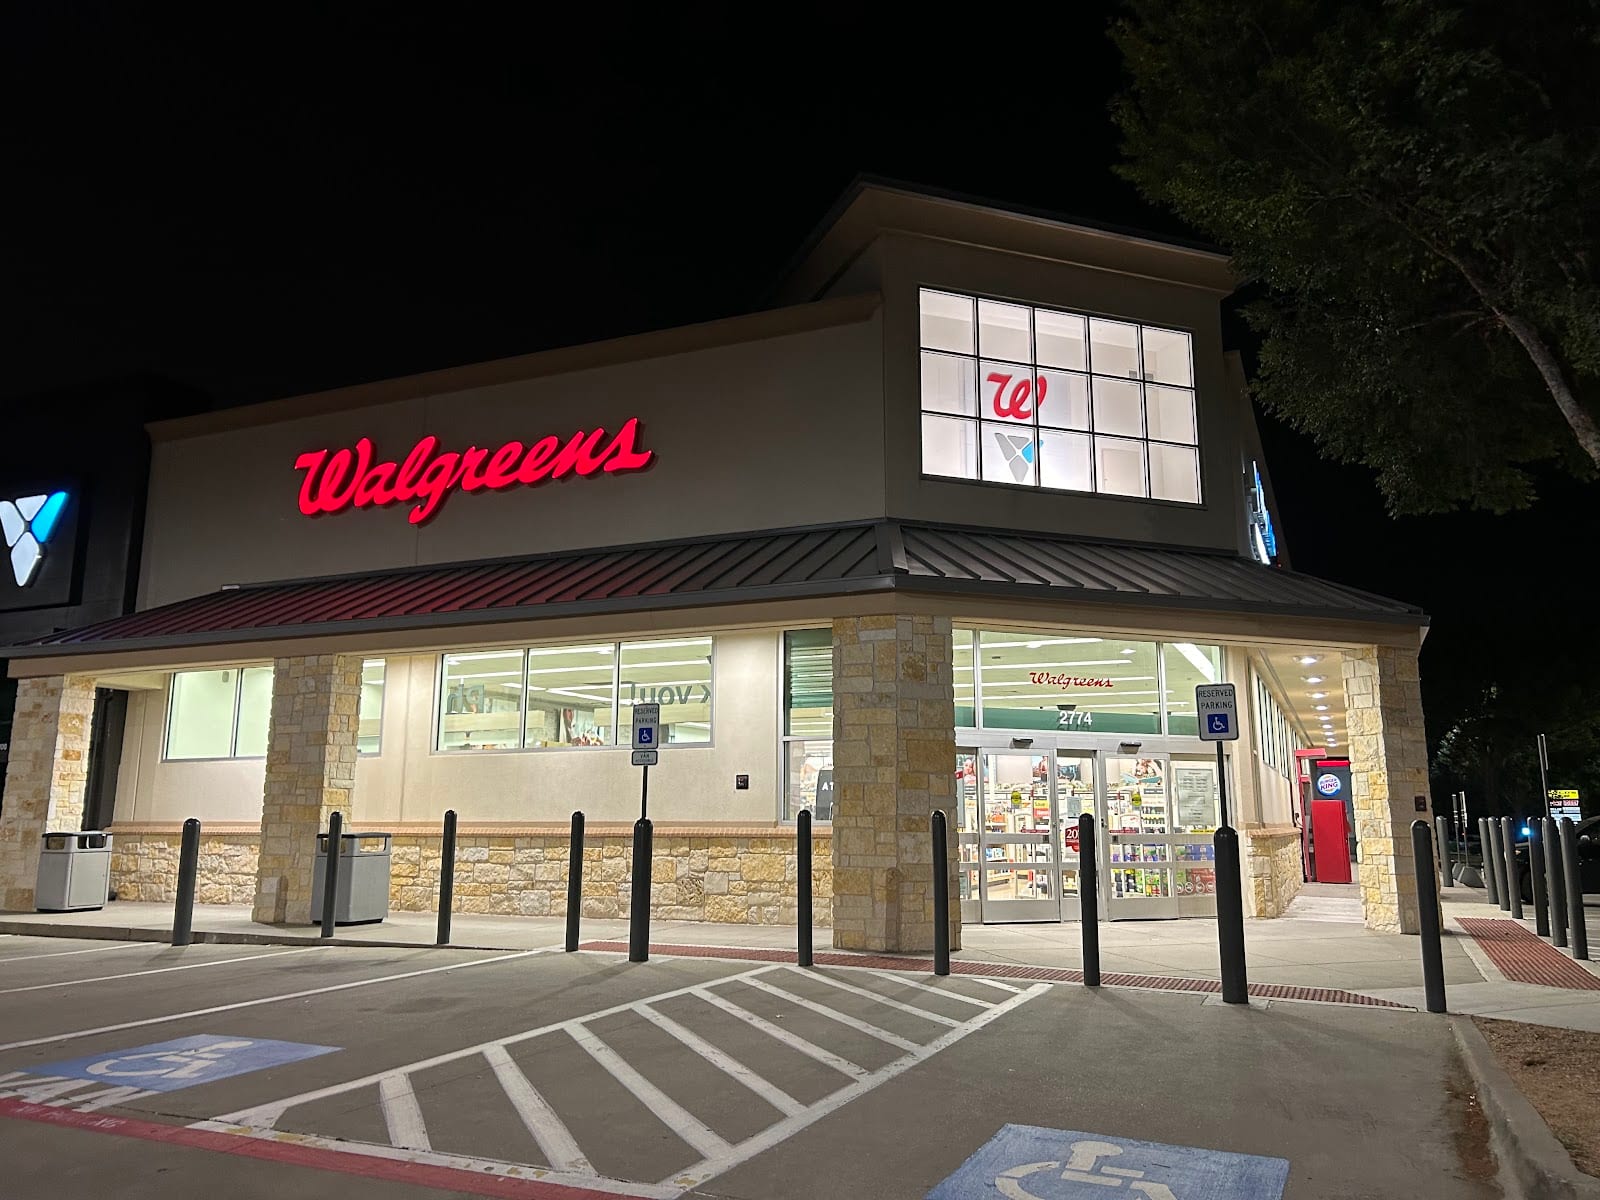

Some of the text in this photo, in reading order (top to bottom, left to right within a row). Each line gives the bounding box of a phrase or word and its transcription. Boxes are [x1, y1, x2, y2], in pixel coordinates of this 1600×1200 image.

[294, 416, 653, 525] Walgreens
[1029, 671, 1114, 690] Walgreens
[1198, 689, 1234, 698] RESERVED
[1200, 701, 1233, 710] PARKING
[634, 707, 658, 715] RESERVED
[635, 716, 657, 724] PARKING
[1059, 711, 1093, 726] 2774
[1320, 781, 1338, 791] KING
